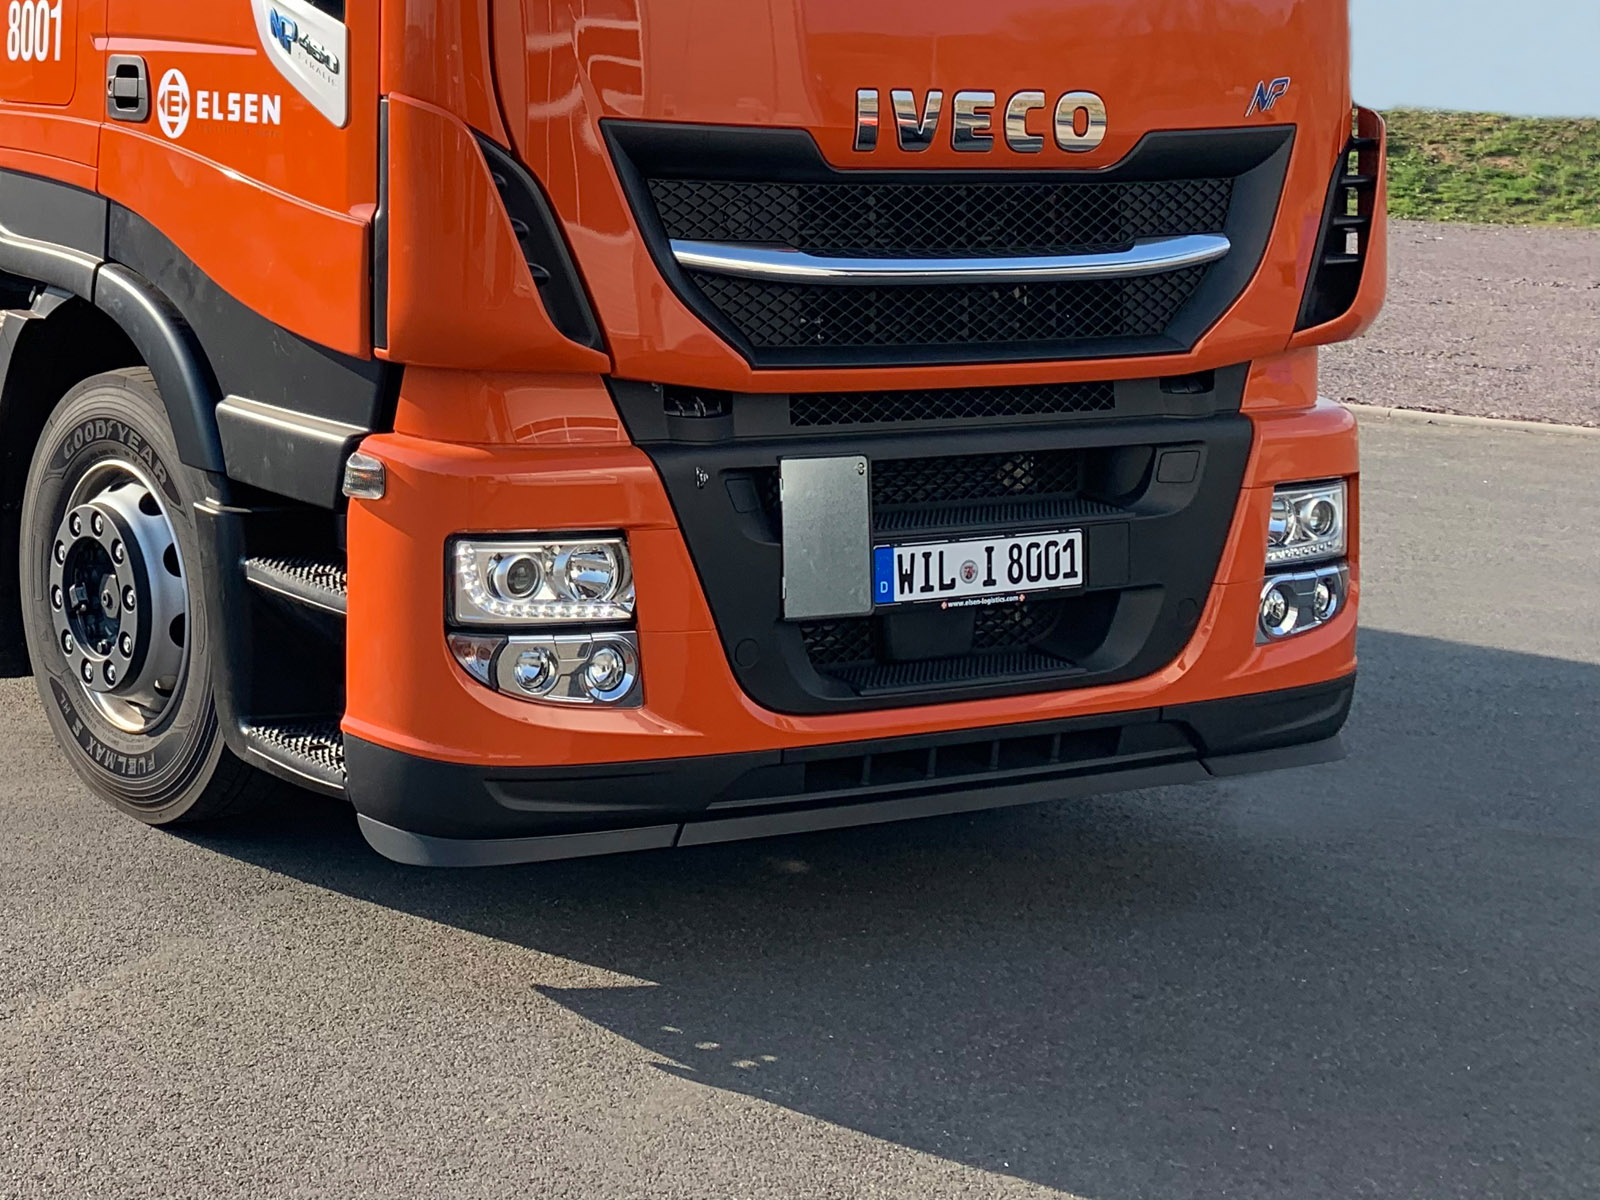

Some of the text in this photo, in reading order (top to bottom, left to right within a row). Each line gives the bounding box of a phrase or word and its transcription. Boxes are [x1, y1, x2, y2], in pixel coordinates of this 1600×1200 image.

[196, 90, 281, 126] ELSEN
[1244, 77, 1291, 117] NP
[851, 87, 1109, 154] IVECO
[63, 419, 167, 486] GOODYEAR
[897, 538, 1078, 595] WIL I 8001
[880, 581, 889, 593] D
[947, 594, 1019, 608] www.elsen-logistics.com
[86, 737, 156, 776] FUELMAX
